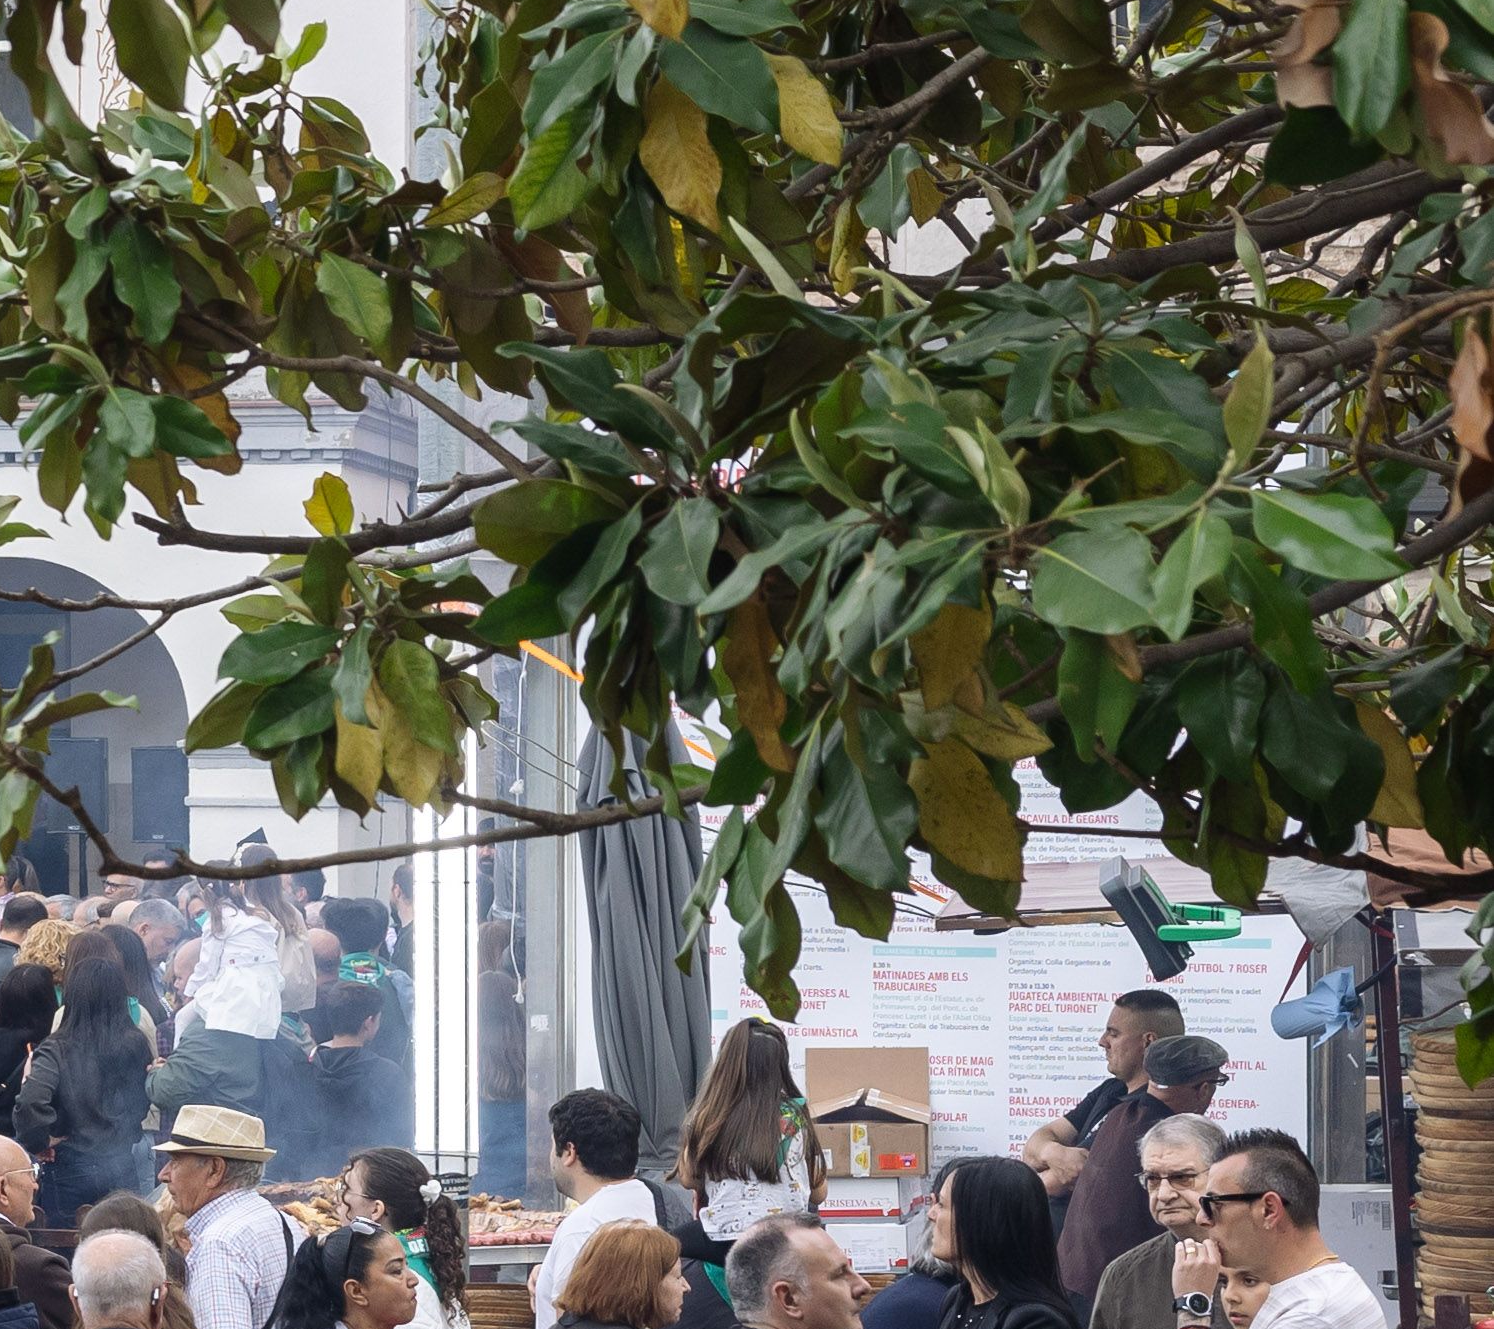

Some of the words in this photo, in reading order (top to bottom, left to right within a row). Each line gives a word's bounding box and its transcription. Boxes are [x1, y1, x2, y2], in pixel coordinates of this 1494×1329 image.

[1062, 814, 1074, 824] DE
[1076, 814, 1120, 824] GEGANTS
[1189, 963, 1225, 973] FUTBOL
[1229, 963, 1234, 973] 7
[1236, 963, 1268, 973] ROSER
[873, 971, 926, 981] MATINADES
[928, 971, 949, 981] AMB
[952, 971, 969, 981] ELS
[873, 982, 938, 992] TRABUCAIRES
[838, 989, 850, 998] AL
[1008, 992, 1055, 1002] JUGATECA
[1057, 992, 1109, 1002] AMBIENTAL
[740, 1000, 763, 1009] PARC
[1009, 1003, 1033, 1013] PARC
[1035, 1003, 1053, 1013] DEL
[1055, 1003, 1098, 1013] TURONET
[787, 1027, 800, 1037] DE
[801, 1027, 858, 1037] GIMNÀSTICA
[929, 1056, 953, 1066] OSER
[955, 1056, 968, 1066] DE
[970, 1056, 994, 1066] MAIG
[1255, 1061, 1267, 1071] AL
[948, 1066, 986, 1077] RÍTMICA
[1009, 1096, 1051, 1106] BALLADA
[1218, 1099, 1260, 1109] GENERA-
[931, 1112, 968, 1122] OPULAR
[1009, 1108, 1046, 1118] DANSES
[1048, 1108, 1060, 1118] DE
